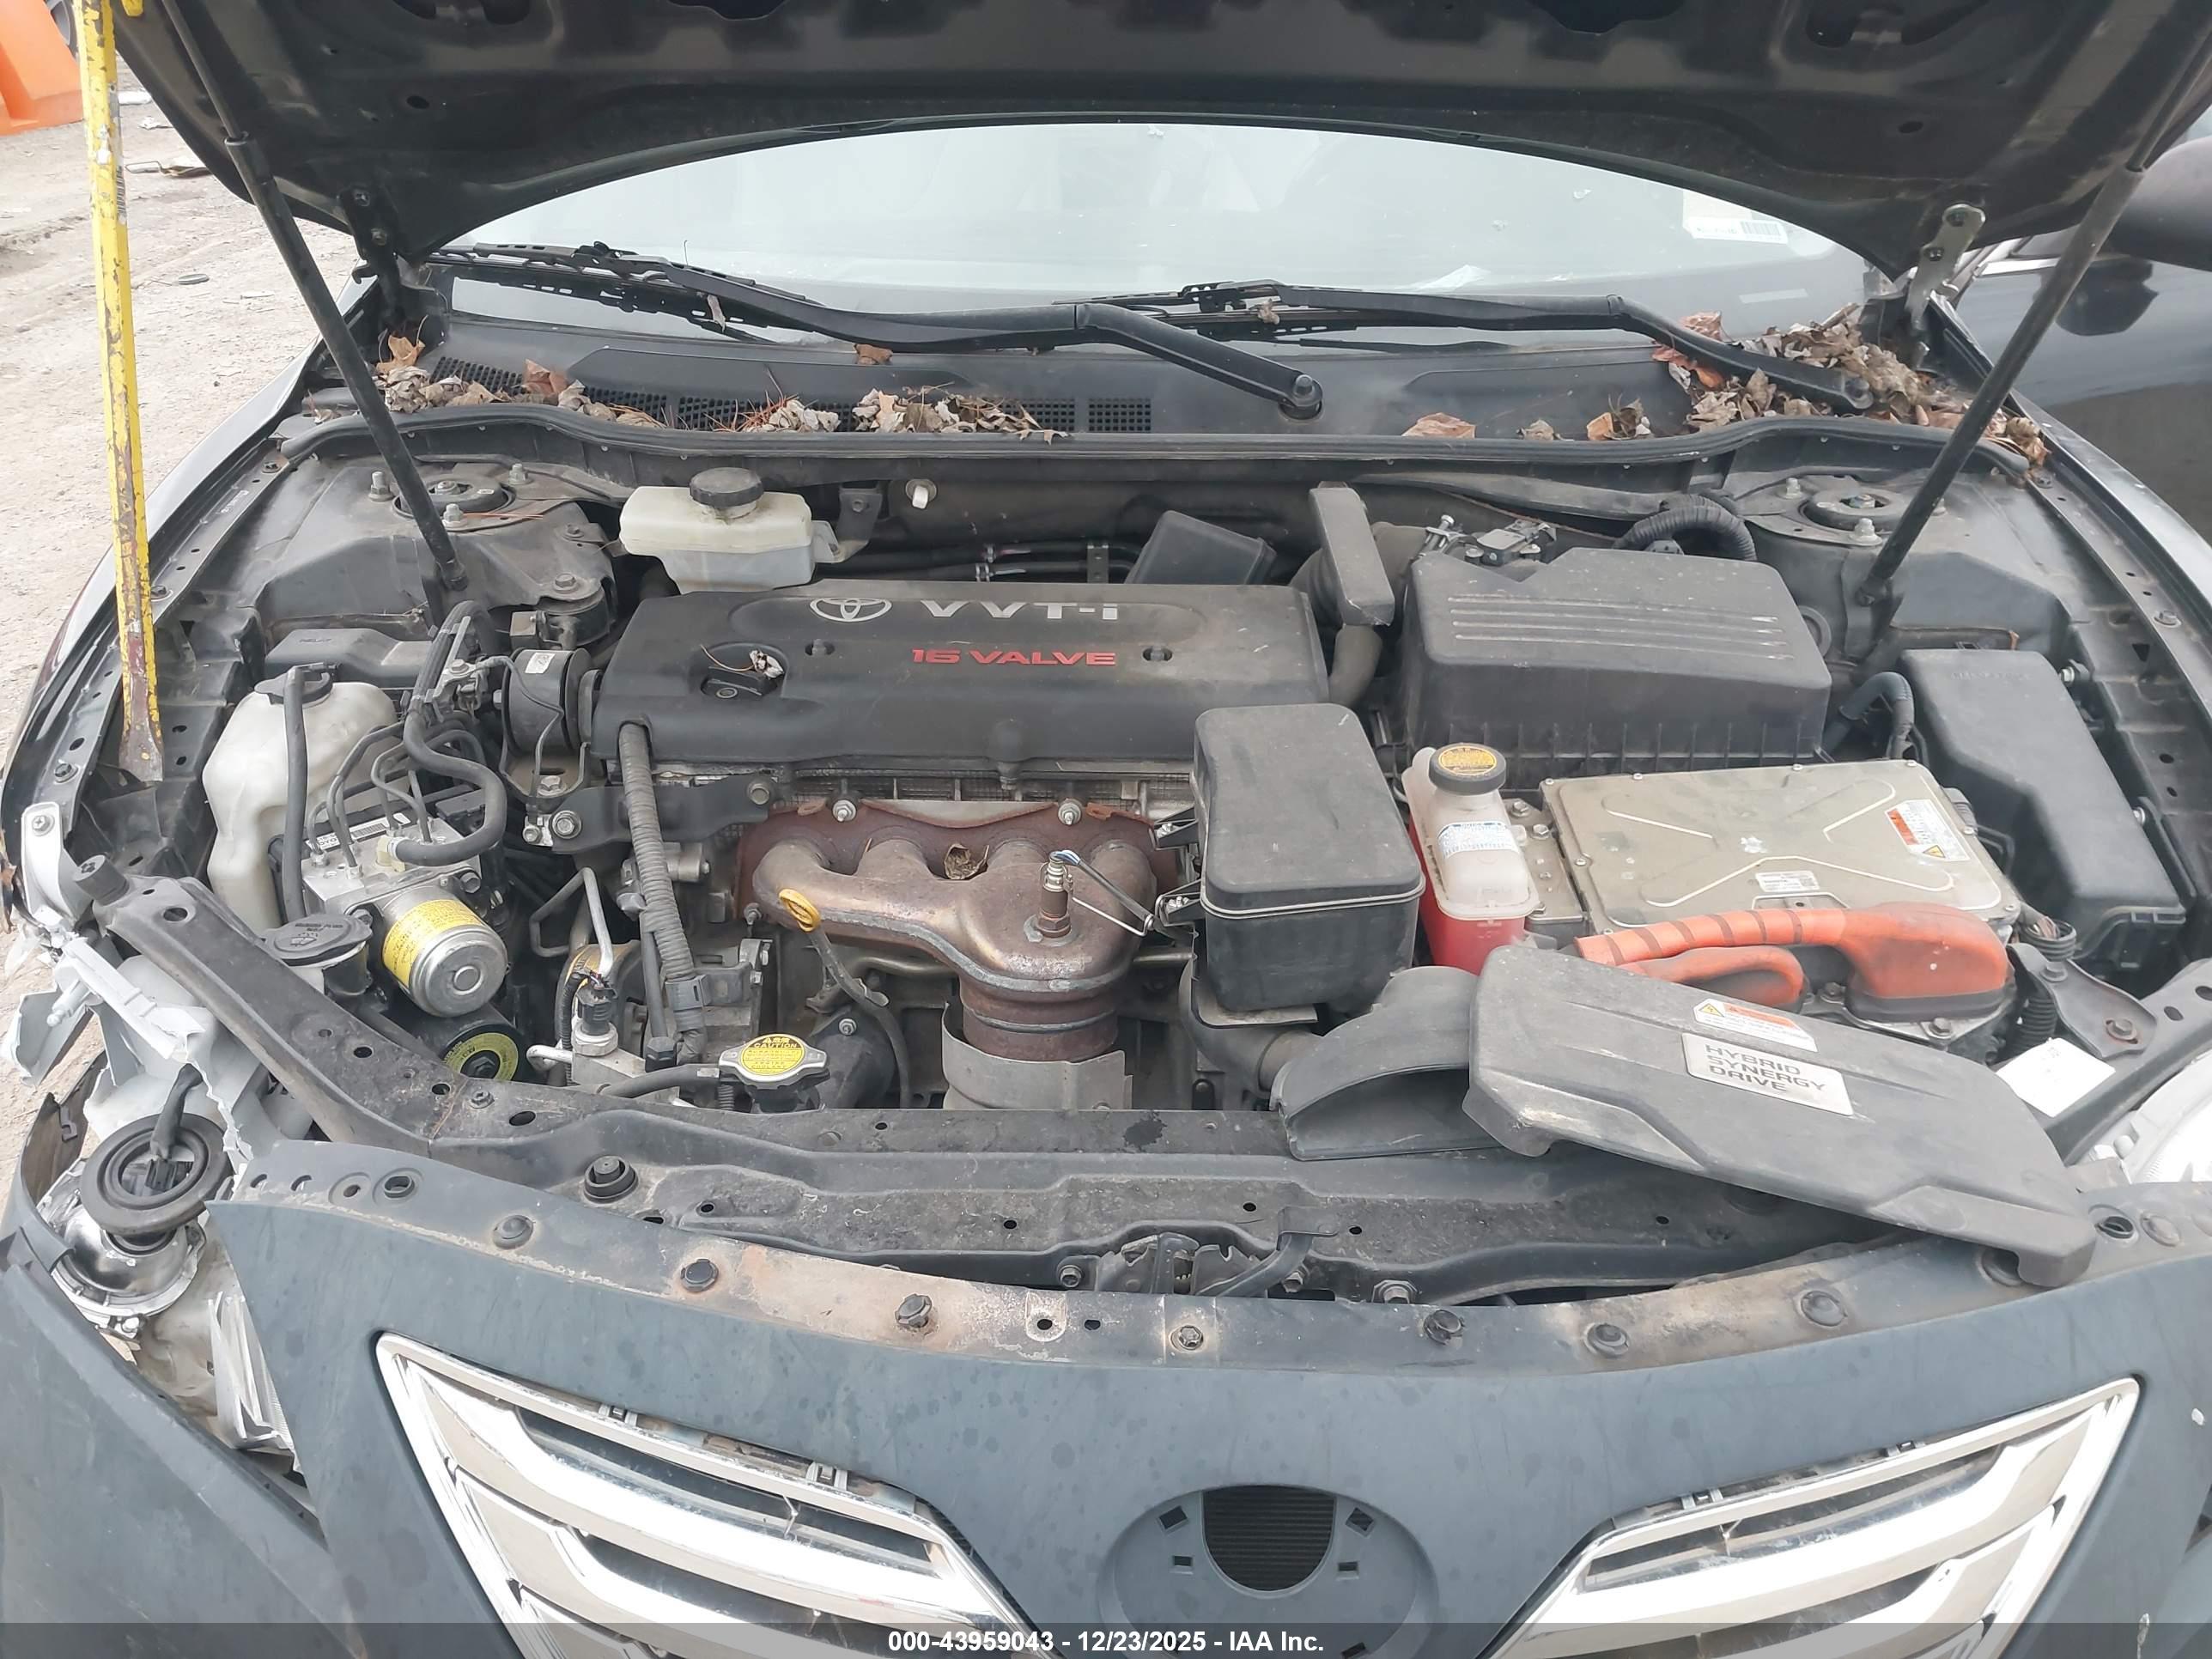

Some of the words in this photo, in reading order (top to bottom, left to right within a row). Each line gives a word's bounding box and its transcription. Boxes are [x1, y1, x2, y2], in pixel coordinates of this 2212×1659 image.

[912, 648, 961, 665] 16
[967, 649, 1116, 665] VALVE
[1705, 1044, 1802, 1075] HYBRID
[1707, 1054, 1827, 1091] SYNERGY
[1709, 1065, 1789, 1093] DRIVE
